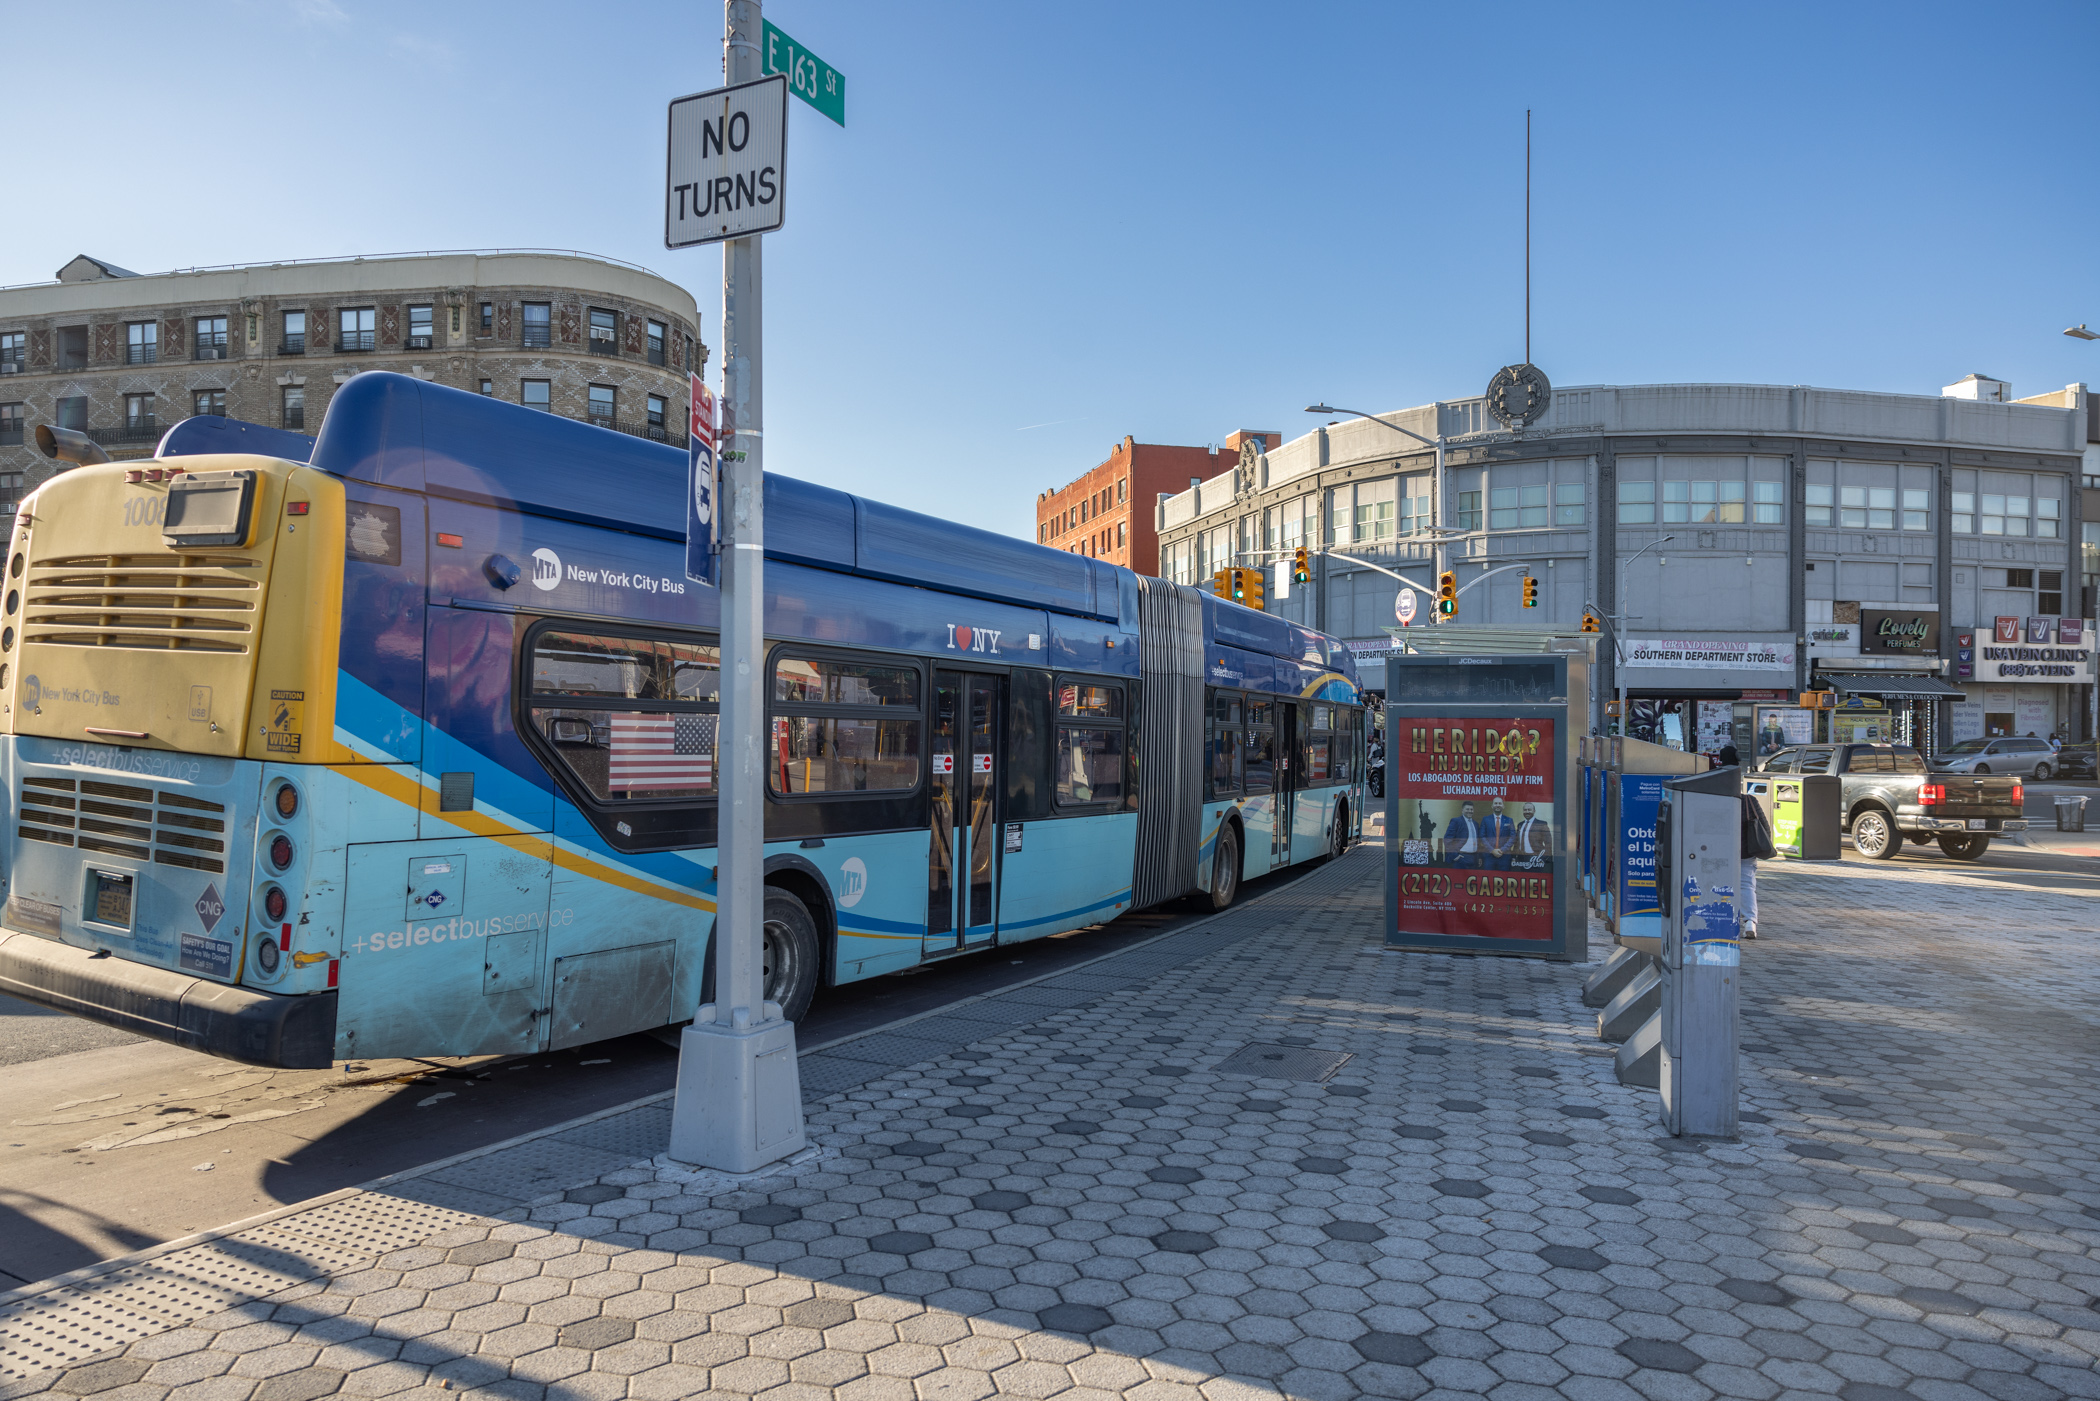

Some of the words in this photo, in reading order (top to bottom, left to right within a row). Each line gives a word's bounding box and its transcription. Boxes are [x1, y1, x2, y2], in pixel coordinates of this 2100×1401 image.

[769, 30, 780, 74] E
[787, 45, 817, 100] 163
[825, 69, 837, 96] St
[702, 111, 750, 159] NO
[673, 166, 777, 221] TURNS
[532, 552, 560, 585] MTA
[567, 564, 598, 583] New
[600, 569, 630, 587] York
[632, 574, 658, 594] City
[661, 577, 685, 594] Bus
[1811, 628, 1850, 641] cricket
[1879, 617, 1930, 640] Lovely
[971, 626, 1002, 654] NY
[1664, 640, 1701, 650] GRAND
[1701, 640, 1746, 650] OPENING
[1886, 639, 1921, 648] PERFUMES
[1458, 657, 1492, 665] JCDecaux
[1634, 650, 1683, 660] SOUTHERN
[1685, 651, 1745, 662] DEPARTMENT
[1746, 653, 1776, 663] STORE
[1984, 647, 2008, 660] USA
[2007, 647, 2040, 661] VEIN
[2041, 648, 2090, 662] CLINICS
[42, 686, 60, 701] New
[62, 687, 81, 703] York
[82, 689, 101, 706] City
[102, 691, 120, 706] Bus
[272, 691, 303, 700] CAUTION
[191, 707, 206, 718] USB
[269, 732, 300, 746] WIDE
[1411, 727, 1541, 755] HERIDO?
[1429, 754, 1521, 773] INJURED?
[1408, 772, 1421, 782] LOS
[1422, 773, 1462, 783] ABOGADOS
[1463, 774, 1473, 783] DE
[1474, 774, 1505, 784] GABRIEL
[1506, 775, 1524, 785] LAW
[1525, 775, 1543, 785] FIRM
[1442, 785, 1481, 796] LUCHARAN
[1482, 785, 1498, 796] POR
[1499, 786, 1507, 796] TI
[1627, 841, 1640, 852] el
[839, 864, 864, 901] MTA
[428, 895, 442, 904] CNG
[43, 904, 60, 917] BUSES
[198, 900, 221, 916] CNG
[148, 925, 159, 935] Bus
[182, 936, 205, 949] SAFETY'S
[205, 940, 216, 951] OUR
[216, 943, 231, 954] GOAL
[182, 946, 193, 955] How
[193, 948, 202, 957] Are
[202, 950, 211, 959] We
[211, 952, 230, 965] Doing?
[194, 958, 205, 967] Call
